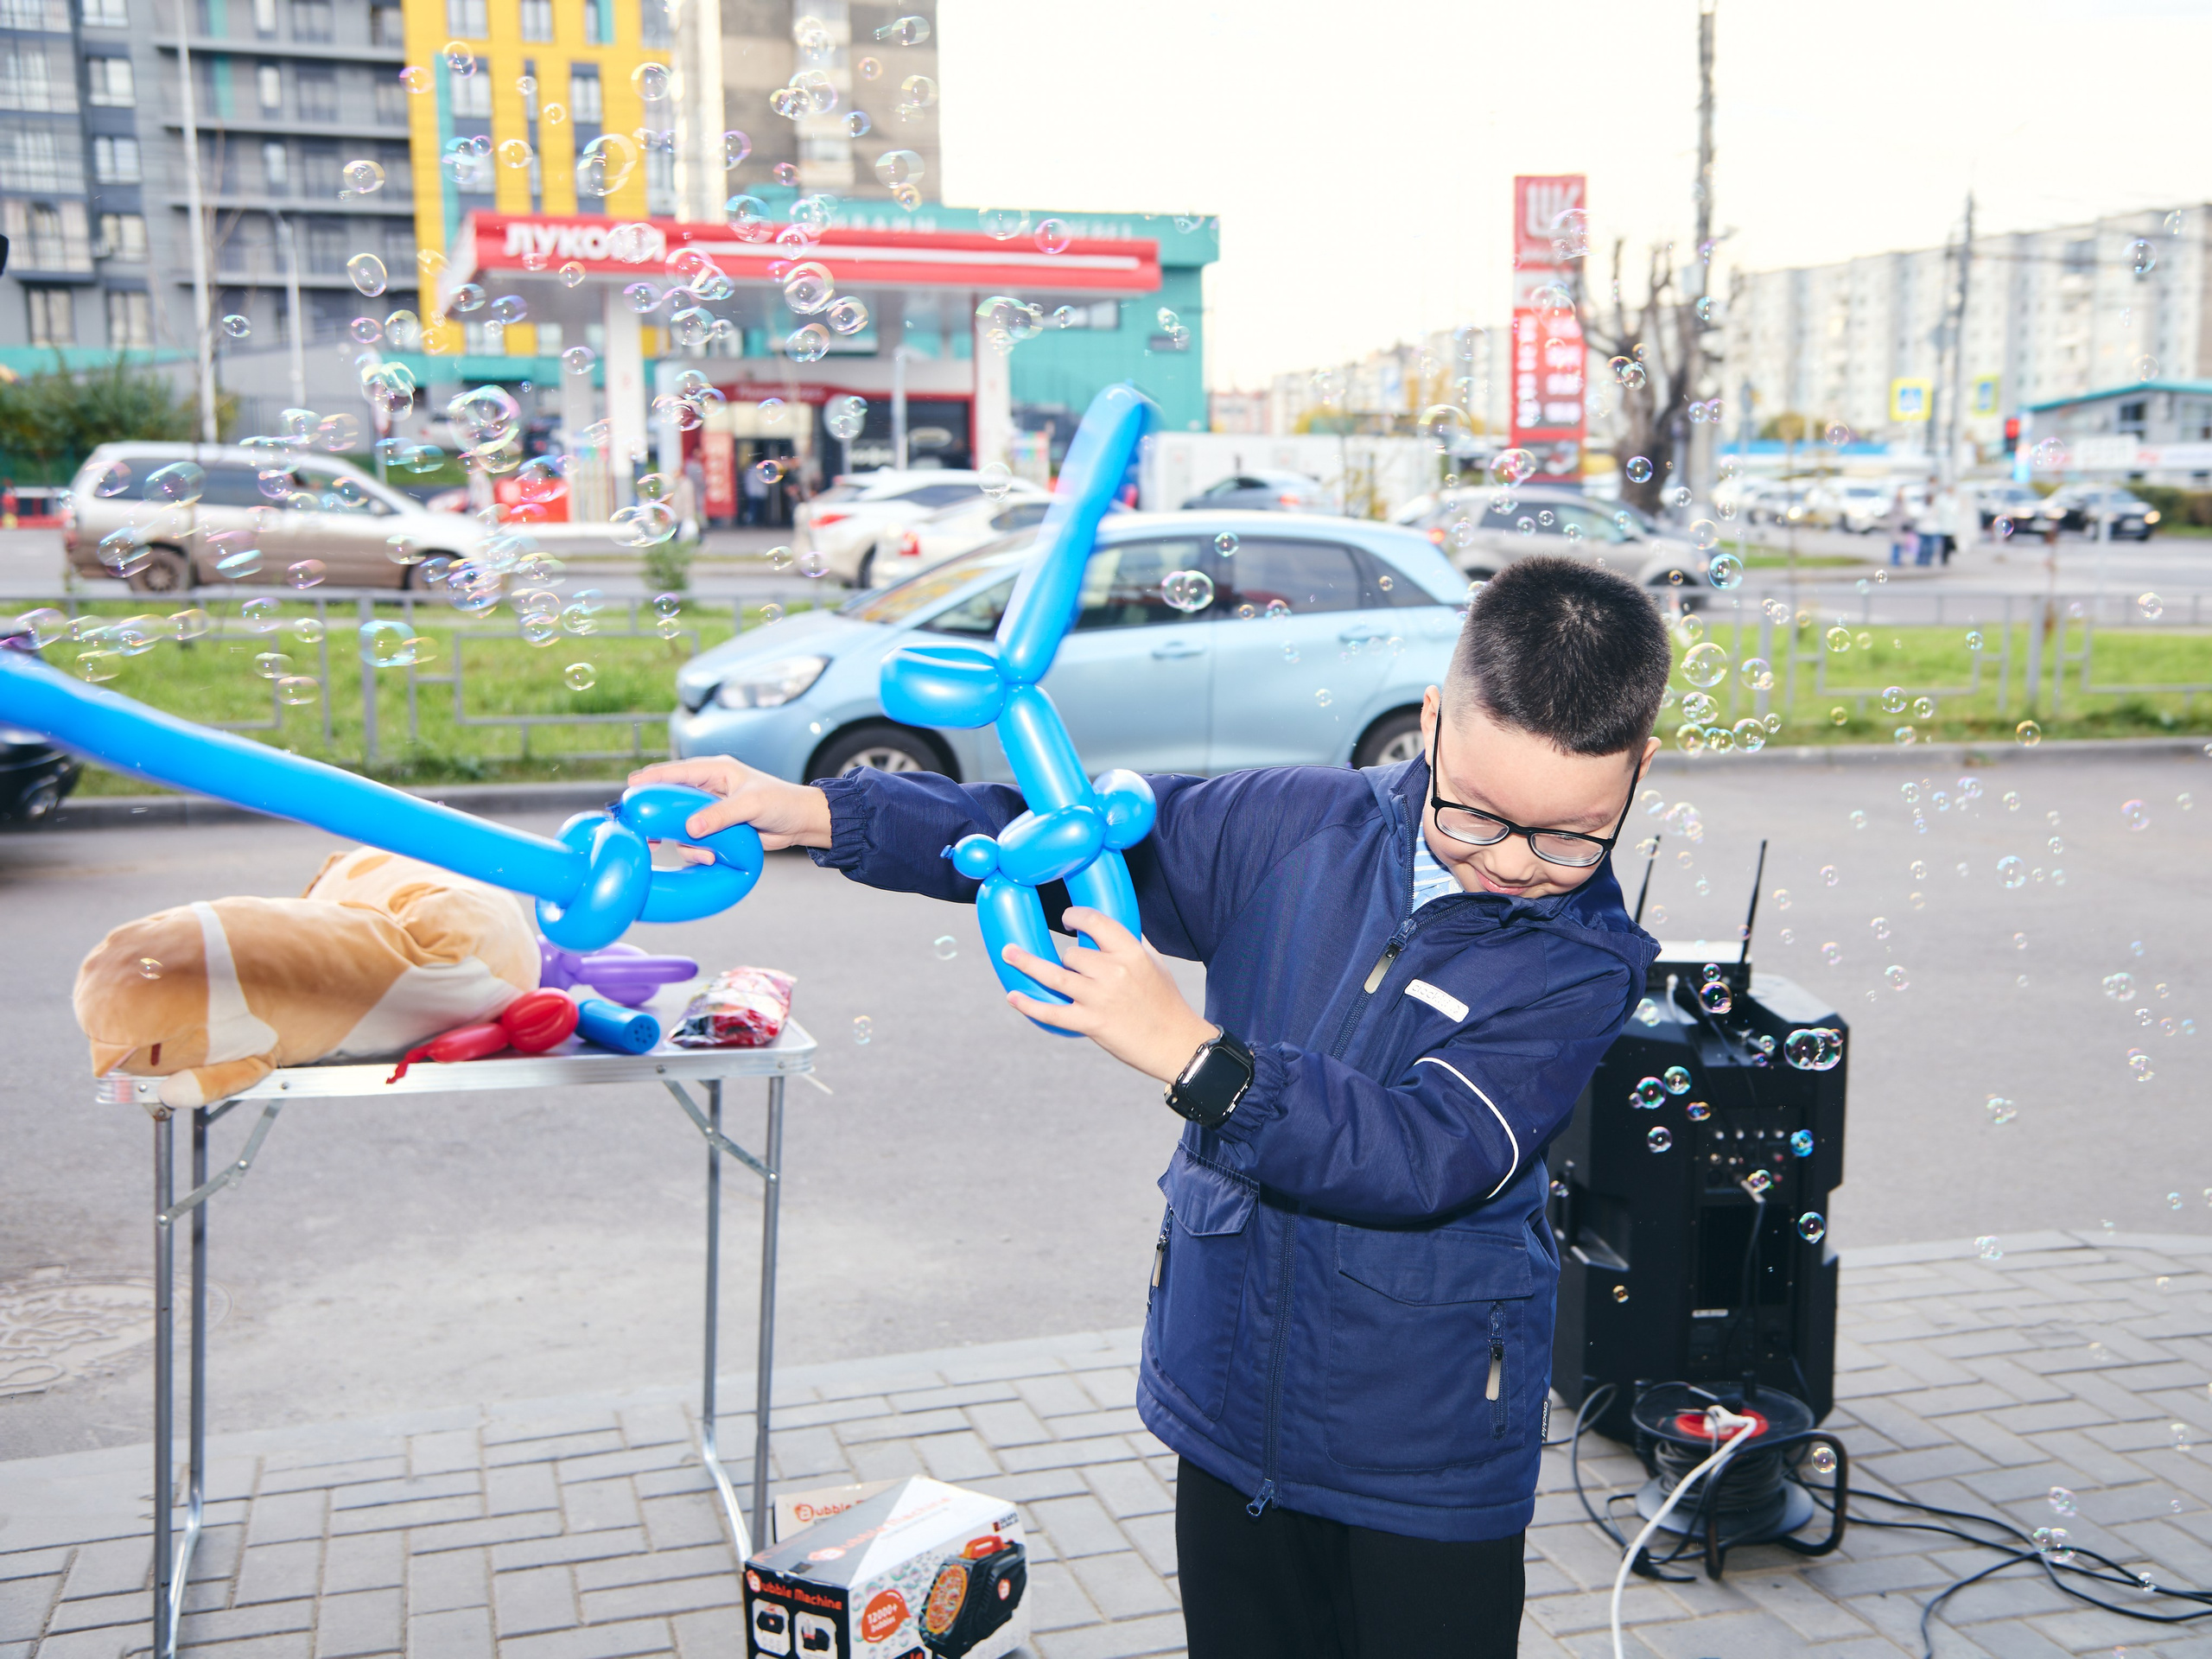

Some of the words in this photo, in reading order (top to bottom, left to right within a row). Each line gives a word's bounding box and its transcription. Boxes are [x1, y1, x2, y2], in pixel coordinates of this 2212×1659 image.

[504, 221, 667, 262] ЛУКОЛ
[793, 1588, 842, 1611] Machine
[867, 1603, 898, 1624] 12000+
